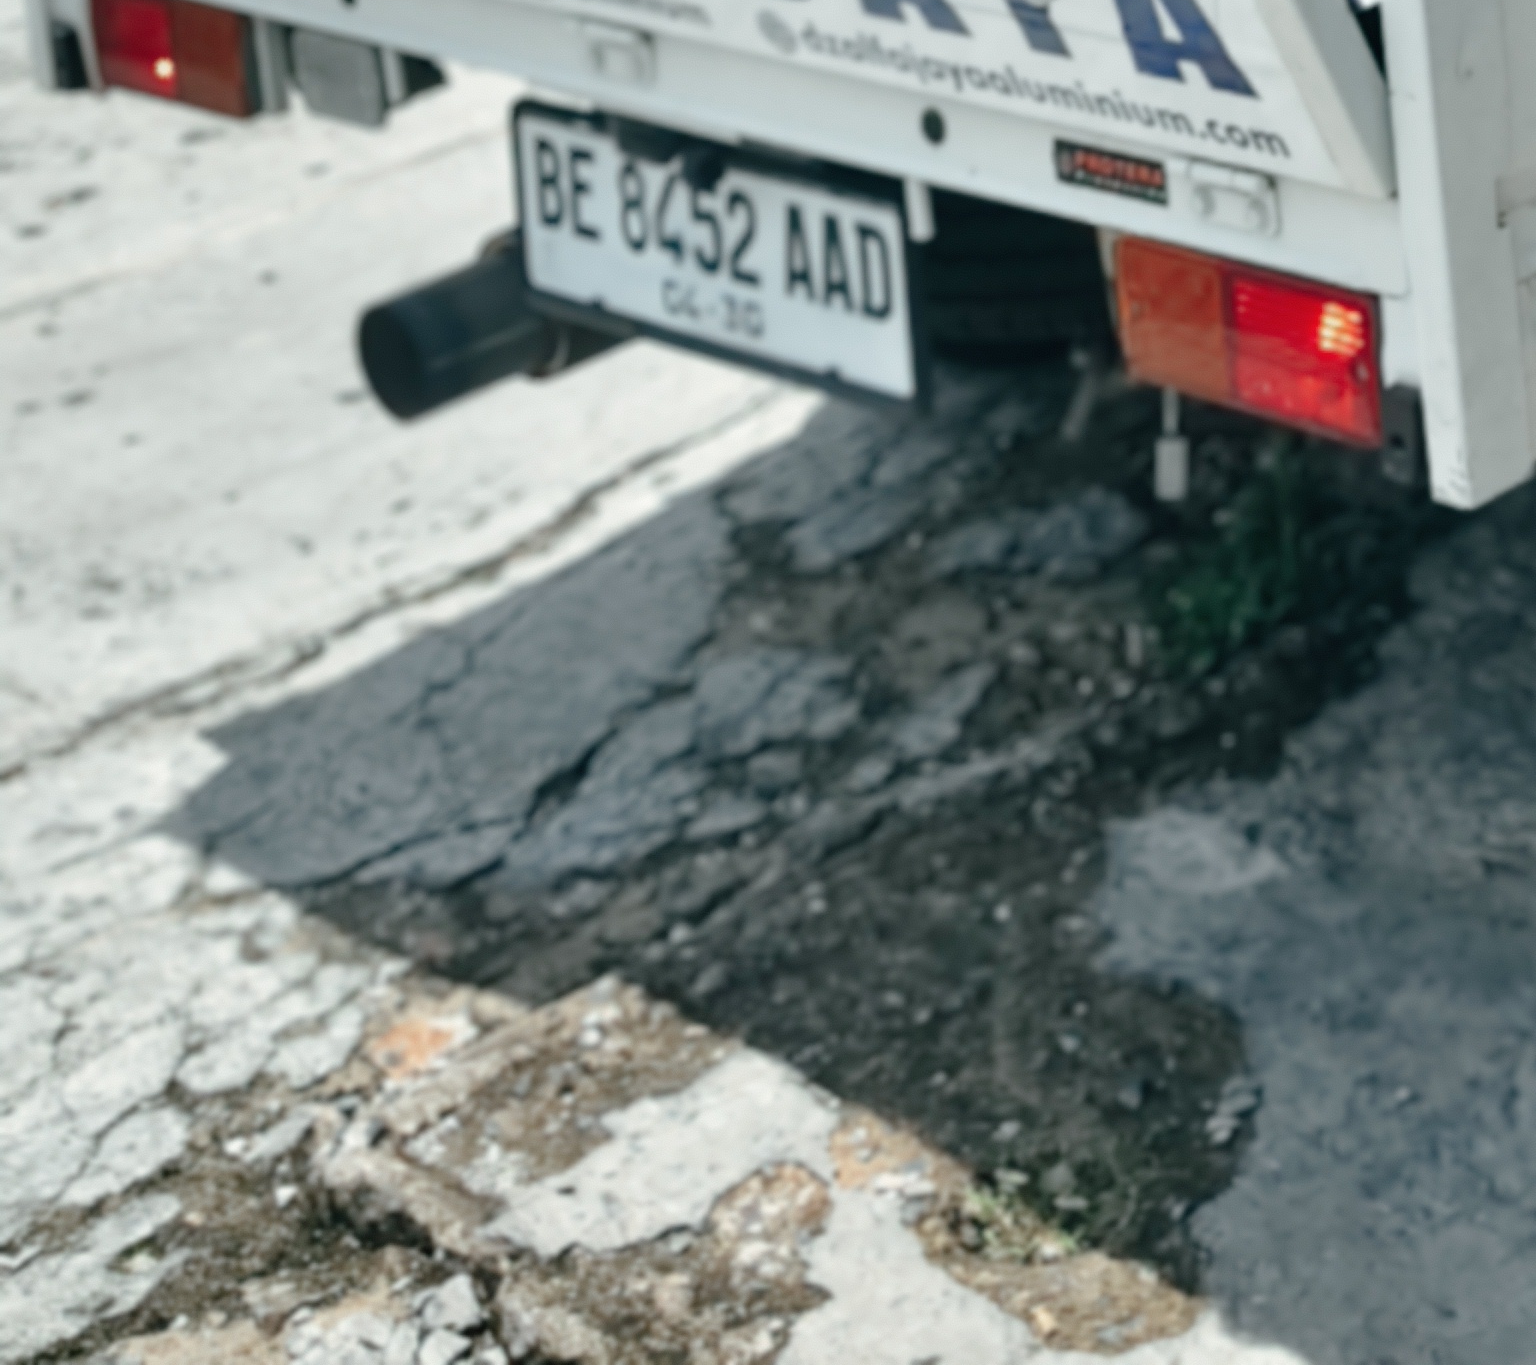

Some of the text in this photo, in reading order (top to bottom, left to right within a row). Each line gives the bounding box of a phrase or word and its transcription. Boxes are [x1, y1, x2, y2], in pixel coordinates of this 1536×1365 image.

[534, 135, 893, 322] BE 8452 AAD
